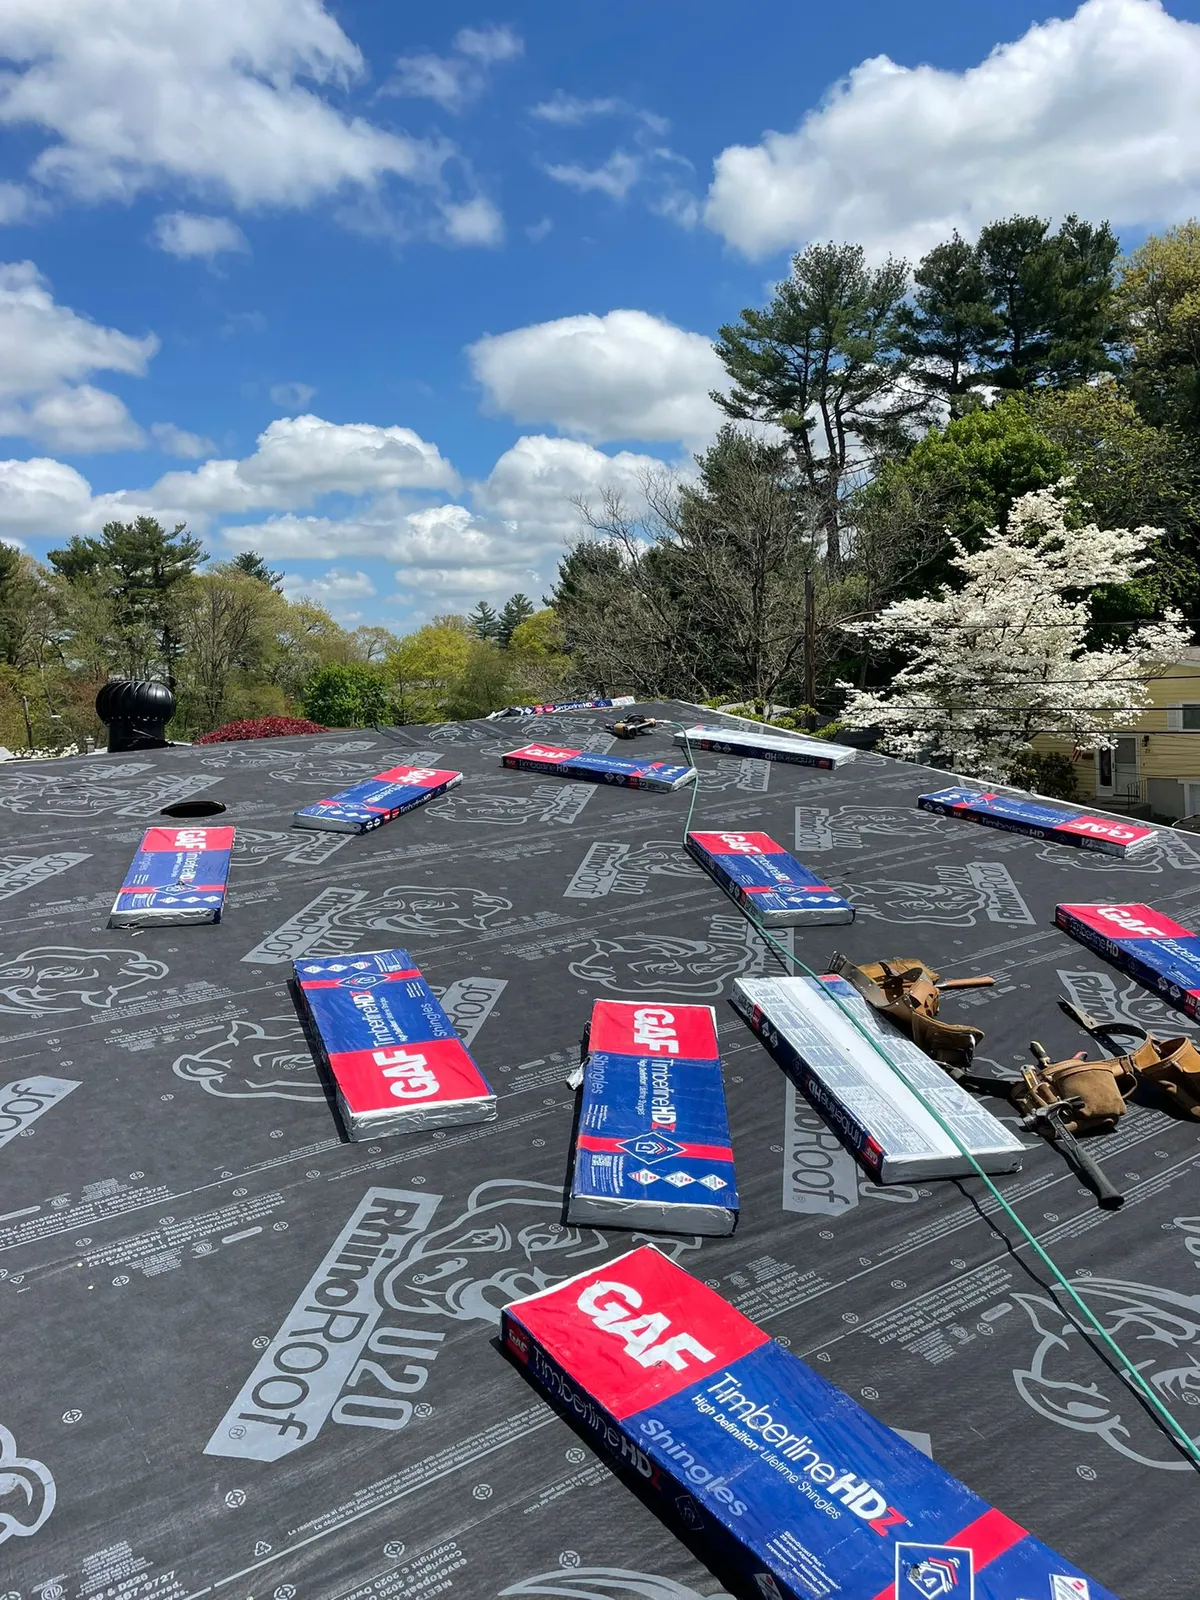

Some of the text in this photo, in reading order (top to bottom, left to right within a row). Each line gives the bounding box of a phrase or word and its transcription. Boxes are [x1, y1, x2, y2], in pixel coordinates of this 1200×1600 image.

[518, 759, 569, 773] TimberlineHD
[525, 749, 572, 759] GAF
[174, 830, 207, 849] GAF
[720, 834, 762, 853] GAF
[982, 817, 1050, 839] TimberlineHD
[1067, 823, 1135, 839] GAF
[610, 873, 649, 895] U20
[708, 914, 749, 941] U20
[1070, 917, 1122, 958] TimberlineHD
[1096, 907, 1167, 936] GAF
[421, 1003, 447, 1037] Shingles
[633, 1008, 679, 1054] GAF
[371, 1050, 440, 1099] GAF
[588, 1054, 609, 1094] Shingles
[508, 1328, 528, 1353] GAF
[577, 1280, 716, 1371] GAF
[331, 1327, 446, 1430] U20
[640, 1417, 748, 1517] Shingles
[690, 1394, 717, 1421] High
[760, 1448, 798, 1485] Lifetime
[796, 1475, 841, 1521] Shingles
[372, 1539, 457, 1589] Copyright 2020
[378, 1548, 463, 1598] Copyright 2020
